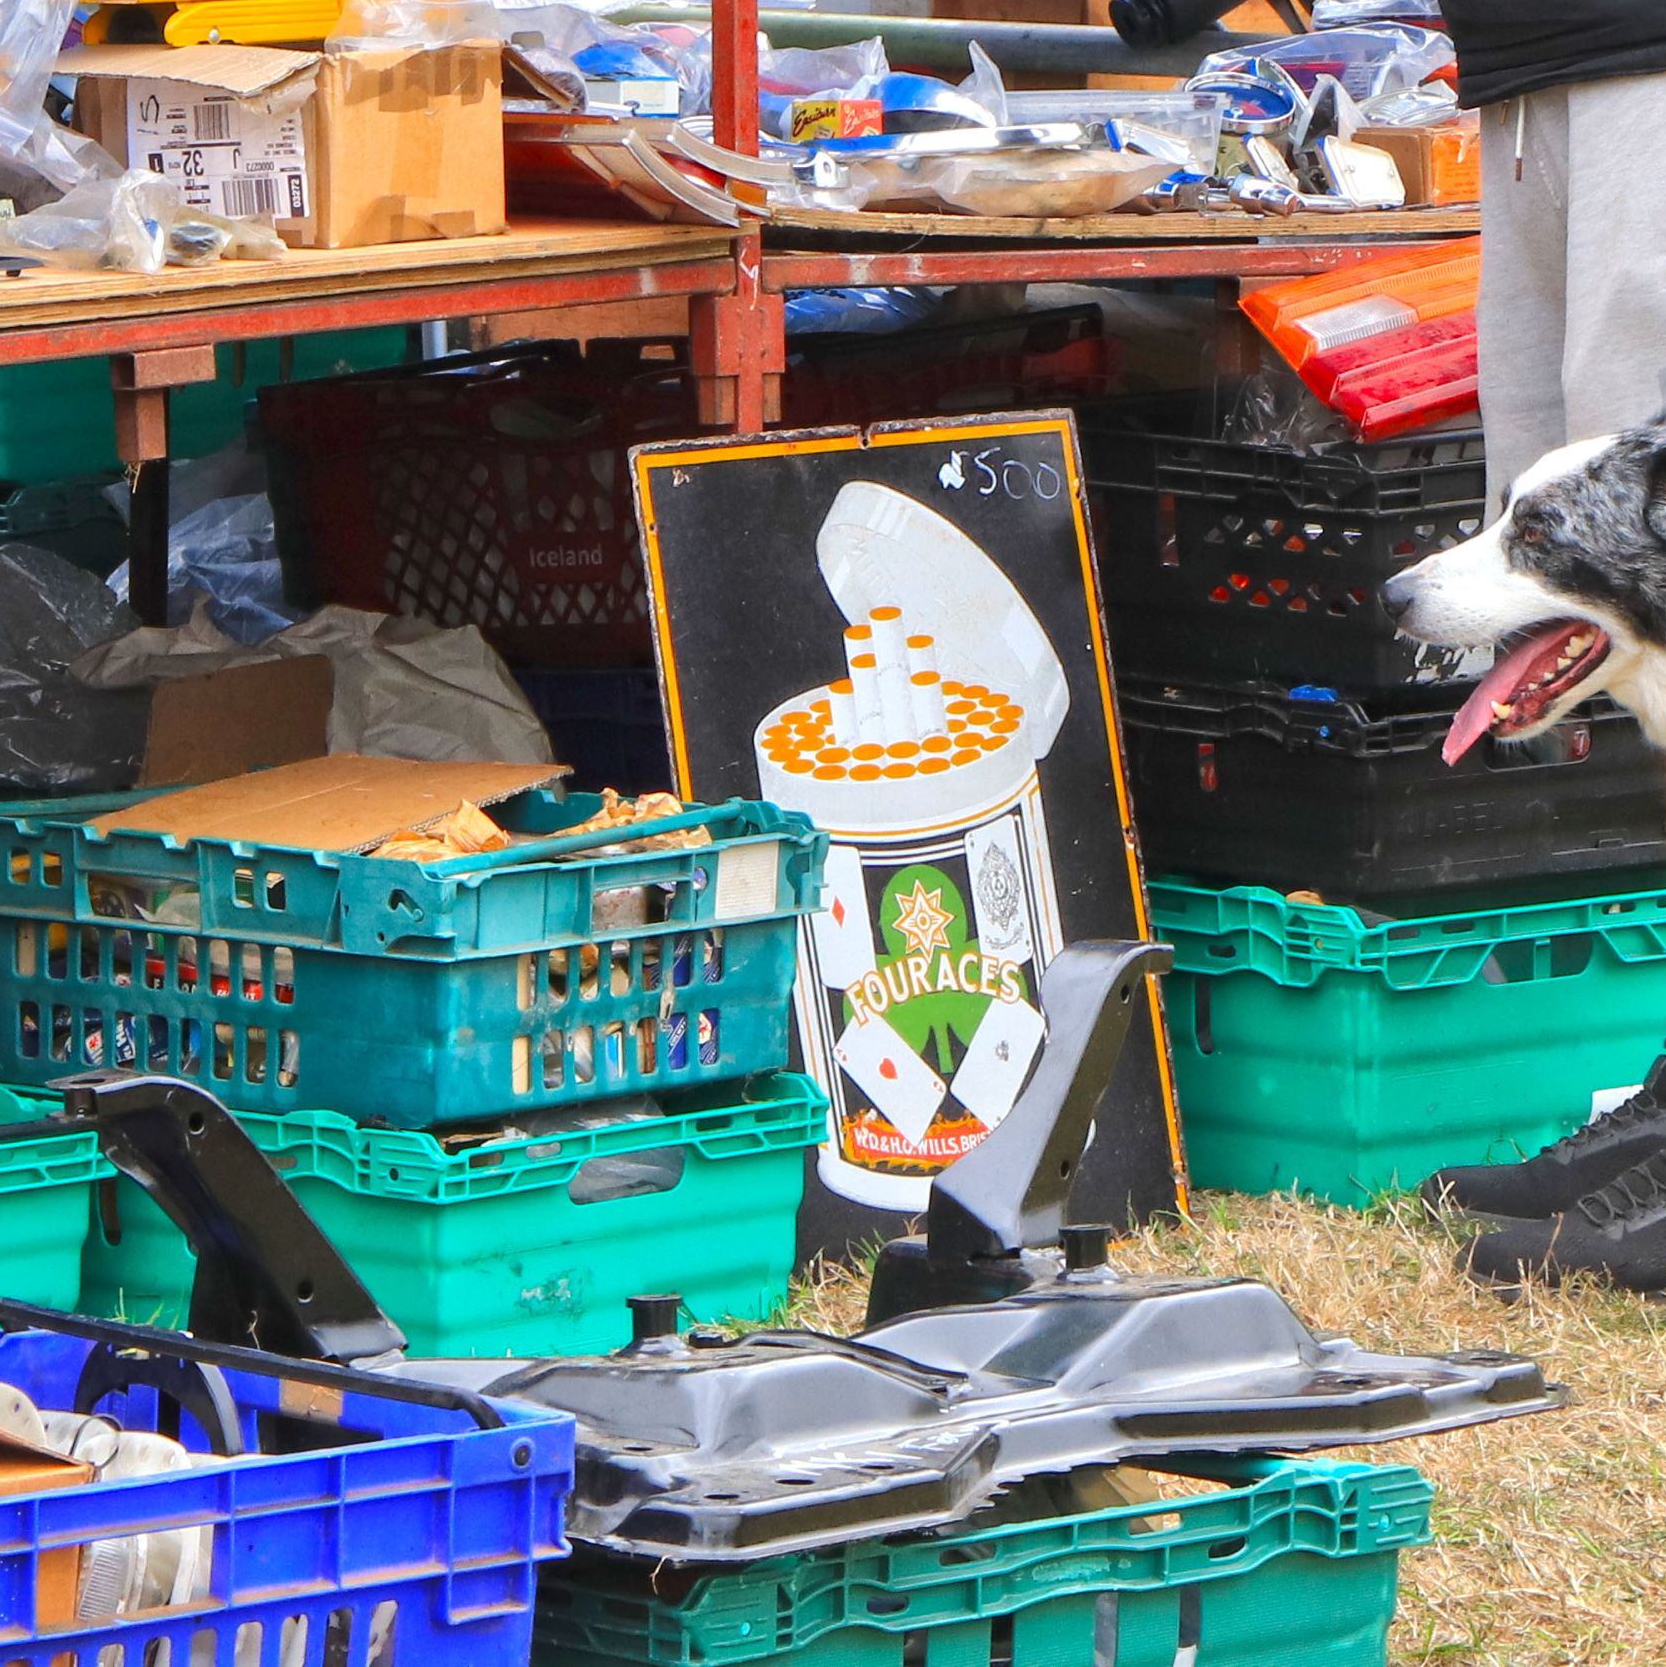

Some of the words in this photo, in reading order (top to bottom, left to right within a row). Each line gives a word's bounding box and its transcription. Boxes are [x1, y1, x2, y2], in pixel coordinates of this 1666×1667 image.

[181, 149, 205, 177] 32
[529, 542, 603, 568] Iceland
[844, 953, 933, 1027] FOUR
[936, 951, 1021, 1005] ACES
